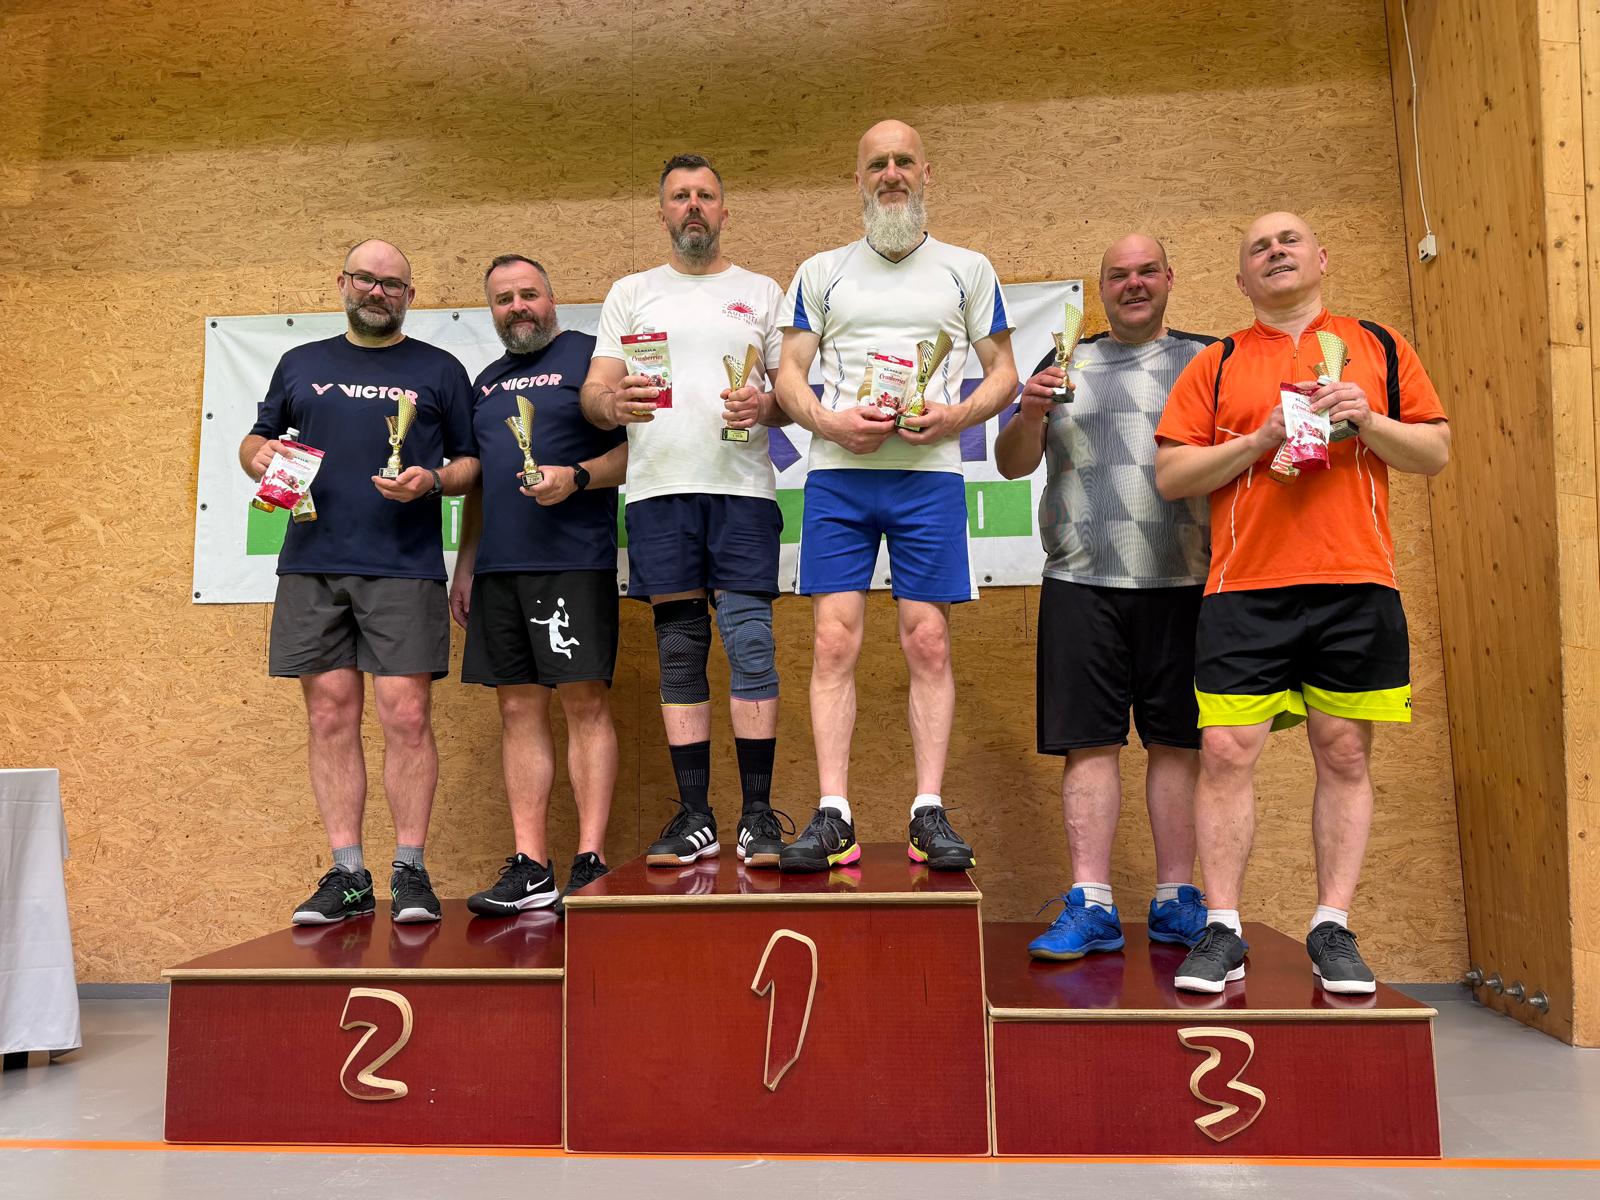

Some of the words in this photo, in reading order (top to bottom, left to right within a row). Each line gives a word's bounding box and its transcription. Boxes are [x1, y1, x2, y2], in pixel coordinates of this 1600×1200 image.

[337, 383, 419, 406] VICTOR
[500, 373, 563, 391] VICTOR
[339, 987, 414, 1101] 2
[751, 928, 819, 1093] 1
[1176, 1026, 1267, 1143] 3
